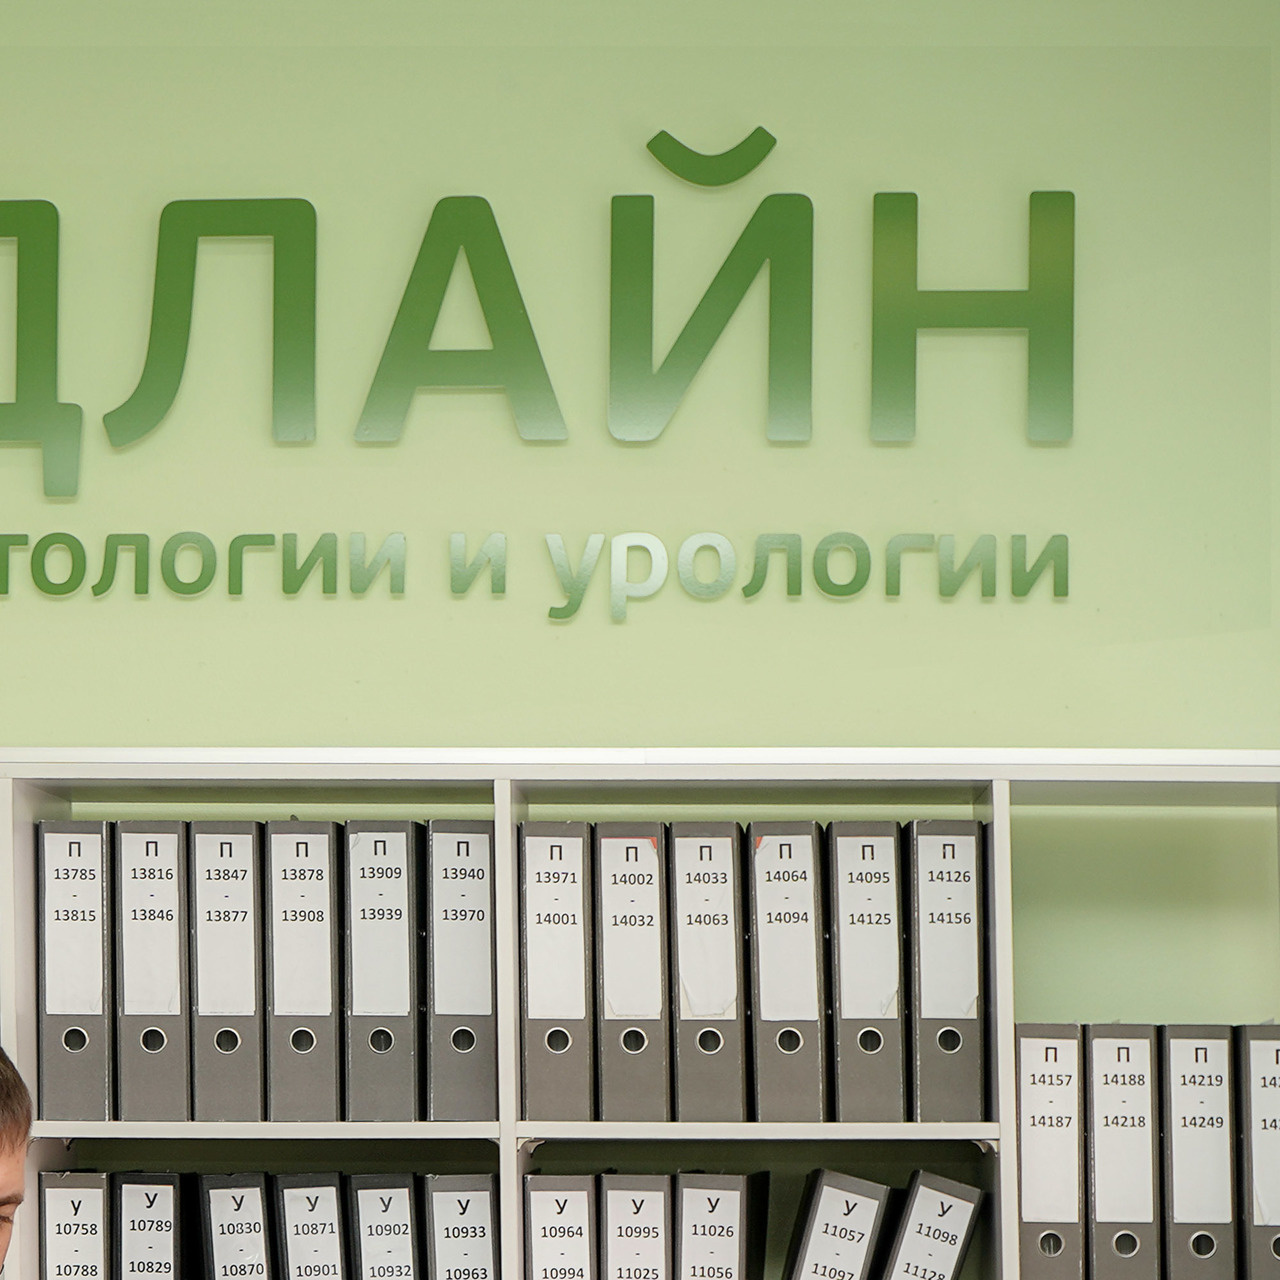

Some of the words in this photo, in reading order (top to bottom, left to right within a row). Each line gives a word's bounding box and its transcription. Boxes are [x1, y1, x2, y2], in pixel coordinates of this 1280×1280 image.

[450, 533, 507, 595] и
[545, 532, 1070, 620] урологии
[55, 869, 95, 880] 13785
[132, 868, 173, 880] 13816
[206, 869, 247, 880] 13847
[282, 869, 323, 880] 13878
[360, 867, 401, 879] 13909
[443, 868, 484, 880] 13940
[536, 872, 577, 883] 13971
[686, 873, 727, 884] 14033
[766, 871, 807, 882] 14064
[848, 872, 890, 883] 14095
[929, 871, 970, 882] 14126
[612, 874, 653, 885] 14002
[55, 910, 95, 921] 13815
[132, 909, 173, 921] 13846
[207, 911, 247, 921] 13877
[283, 910, 324, 922] 13908
[361, 909, 402, 920] 13939
[443, 909, 484, 921] 13970
[536, 913, 577, 925] 14001
[613, 915, 654, 926] 14032
[687, 914, 728, 925] 14063
[767, 912, 808, 923] 14094
[850, 913, 891, 925] 14125
[929, 913, 971, 924] 14156
[1031, 1074, 1072, 1086] 14157
[1104, 1074, 1145, 1086] 14188
[1181, 1075, 1223, 1086] 14219
[1031, 1116, 1072, 1127] 14187
[1104, 1116, 1145, 1127] 14218
[1182, 1117, 1223, 1128] 14249
[56, 1223, 97, 1235] 10758
[130, 1220, 172, 1232] 10789
[219, 1222, 261, 1235] 10830
[294, 1223, 335, 1235] 10871
[368, 1224, 409, 1236] 10902
[445, 1226, 486, 1238] 10933
[542, 1226, 583, 1238] 10964
[618, 1226, 659, 1238] 10995
[692, 1224, 733, 1237] 11026
[823, 1223, 865, 1243] 11057
[916, 1223, 958, 1245] 11098
[56, 1265, 97, 1276] 10788
[130, 1261, 171, 1273] 10829
[222, 1263, 264, 1276] 10870
[297, 1264, 338, 1277] 10901
[370, 1265, 411, 1277] 10932
[691, 1266, 732, 1279] 11056
[446, 1268, 487, 1280] 10963
[543, 1268, 584, 1279] 10994
[617, 1268, 658, 1280] 11025
